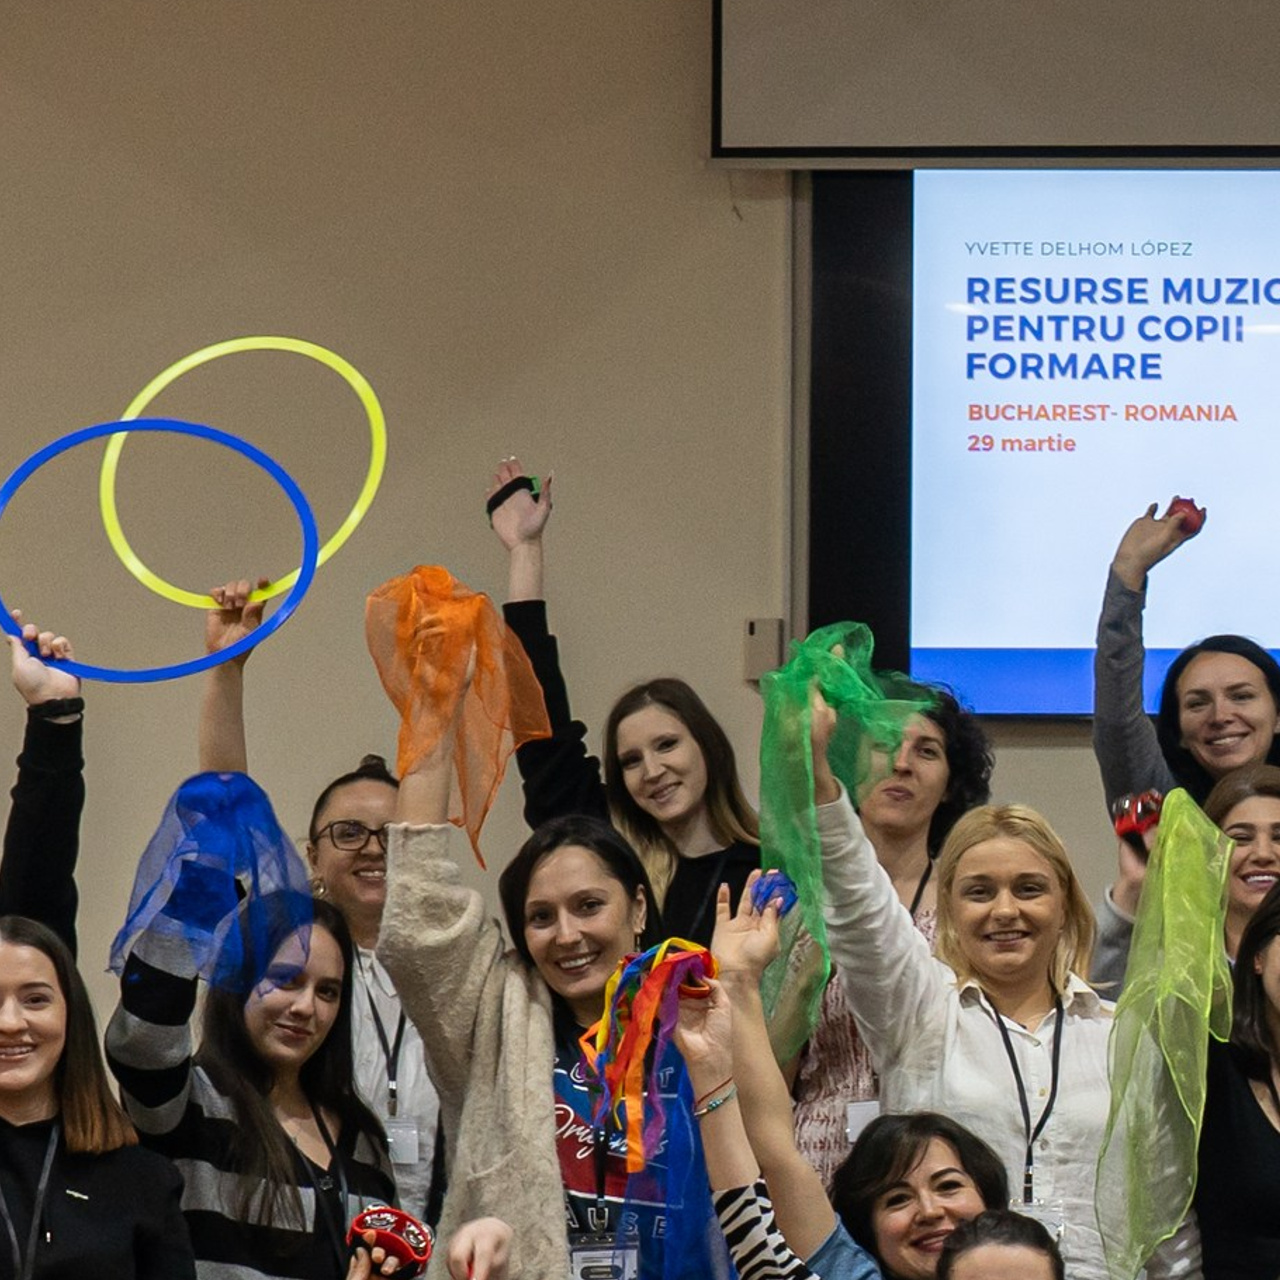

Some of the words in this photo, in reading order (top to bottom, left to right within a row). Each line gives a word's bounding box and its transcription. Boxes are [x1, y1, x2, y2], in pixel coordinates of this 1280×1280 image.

[965, 242, 1034, 256] YVETTE
[1040, 242, 1124, 256] DELHOM
[1131, 239, 1193, 256] LÓPEZ
[967, 277, 1149, 304] RESURSE
[967, 315, 1125, 342] PENTRU
[1137, 315, 1243, 342] COPII
[966, 353, 1162, 380] FORMARE
[968, 404, 1118, 421] BUCHAREST-
[1125, 404, 1238, 421] ROMANIA
[967, 434, 995, 452] 29
[1002, 434, 1077, 452] martie
